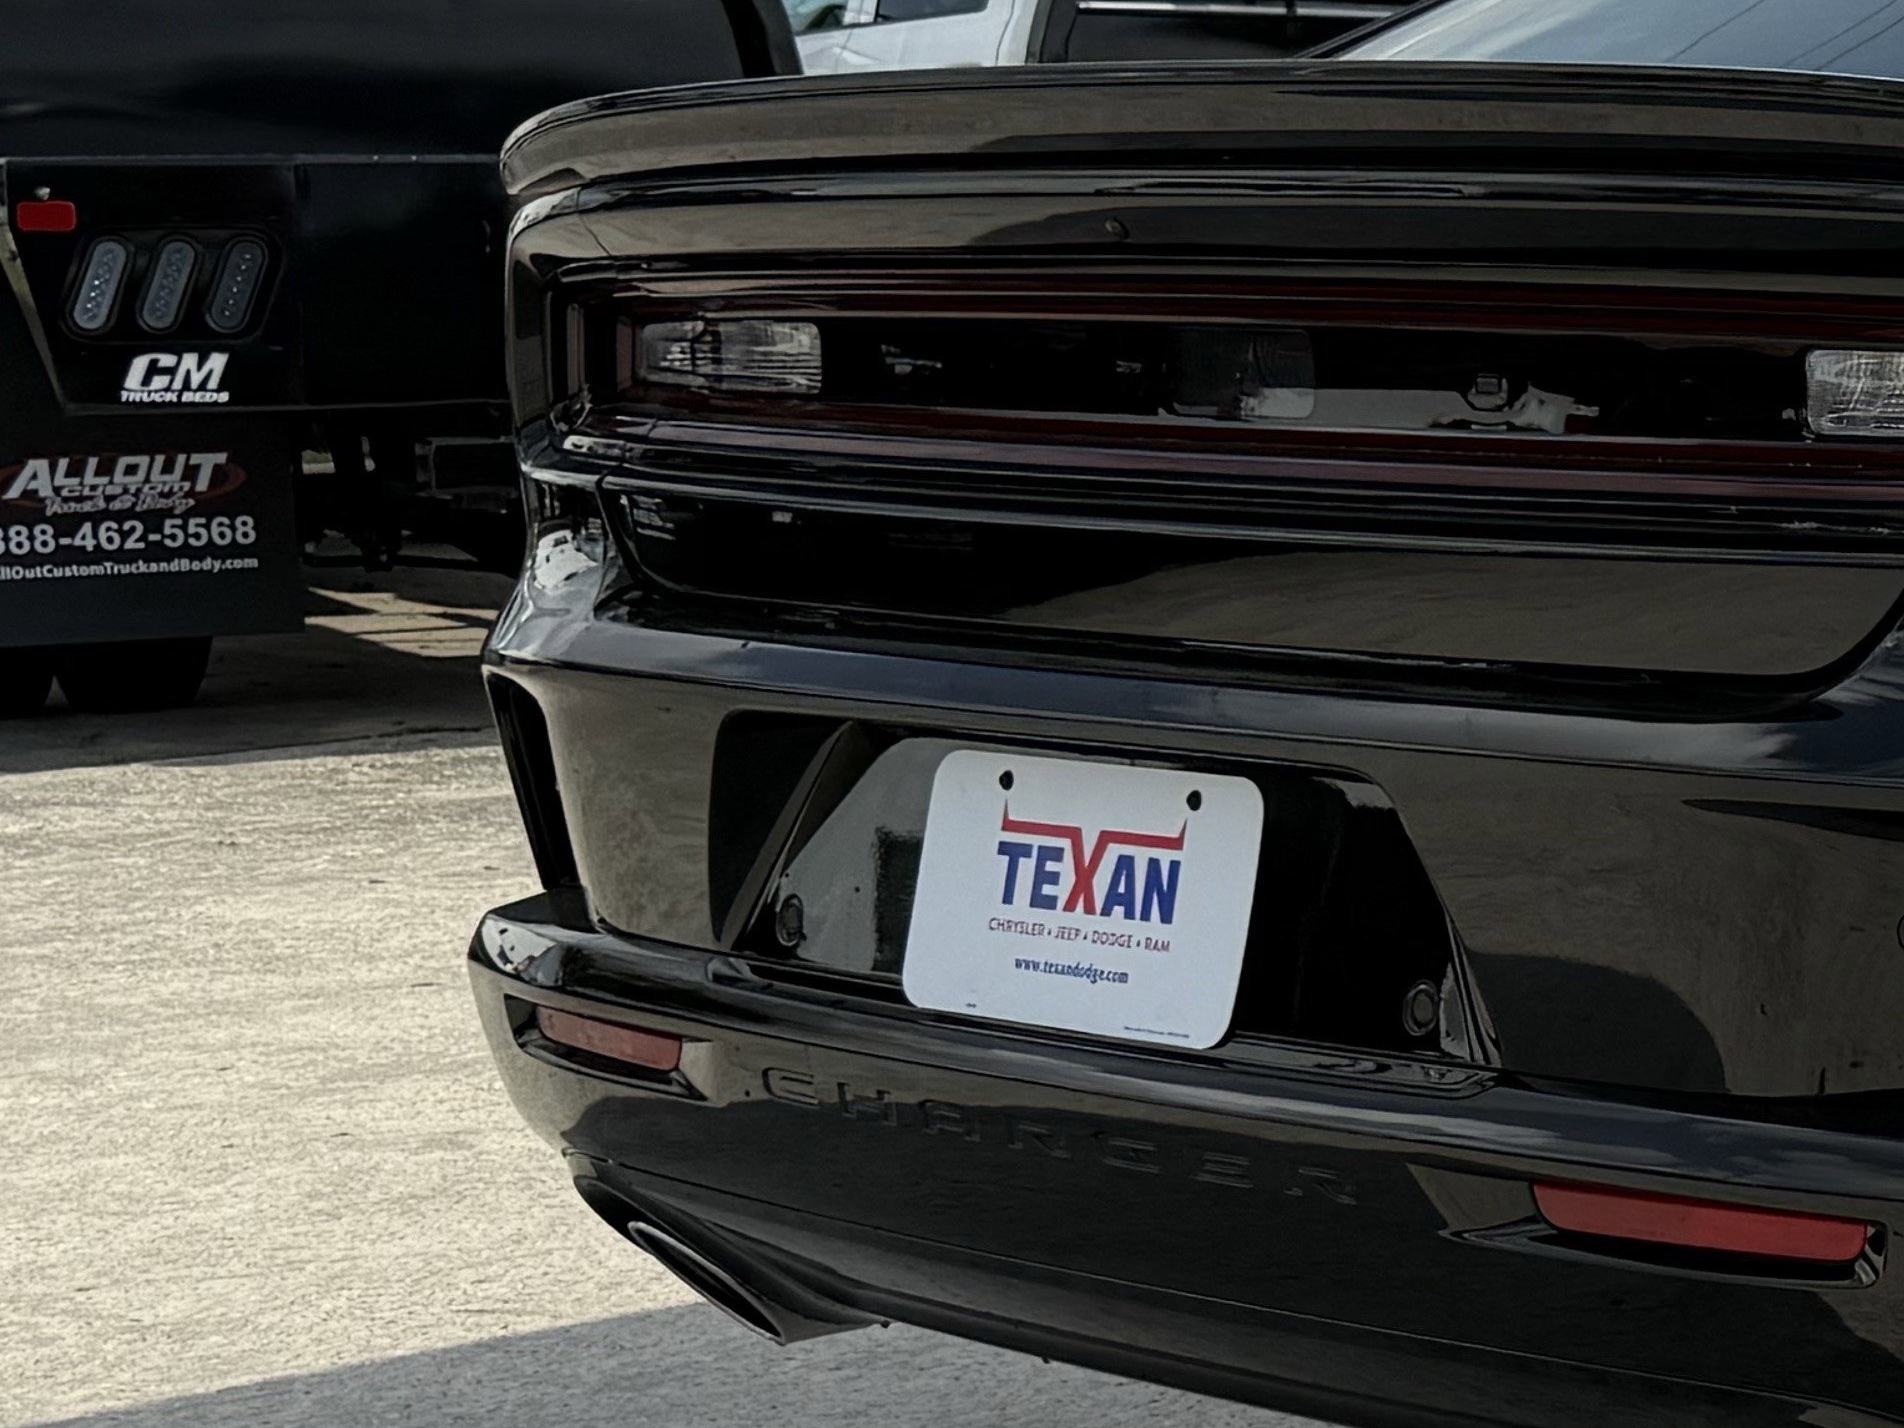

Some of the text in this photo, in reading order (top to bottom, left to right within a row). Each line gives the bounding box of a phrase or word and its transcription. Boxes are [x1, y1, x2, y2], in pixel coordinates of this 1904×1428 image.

[123, 352, 229, 390] CM
[120, 391, 179, 402] TRUCK
[1, 452, 228, 500] ALLOUT
[0, 515, 257, 556] 88-462-5568
[998, 810, 1187, 925] TEXAN
[988, 917, 1170, 953] CHRYSLER JEEP DODGE RAM
[762, 1067, 1358, 1205] CHARGER
